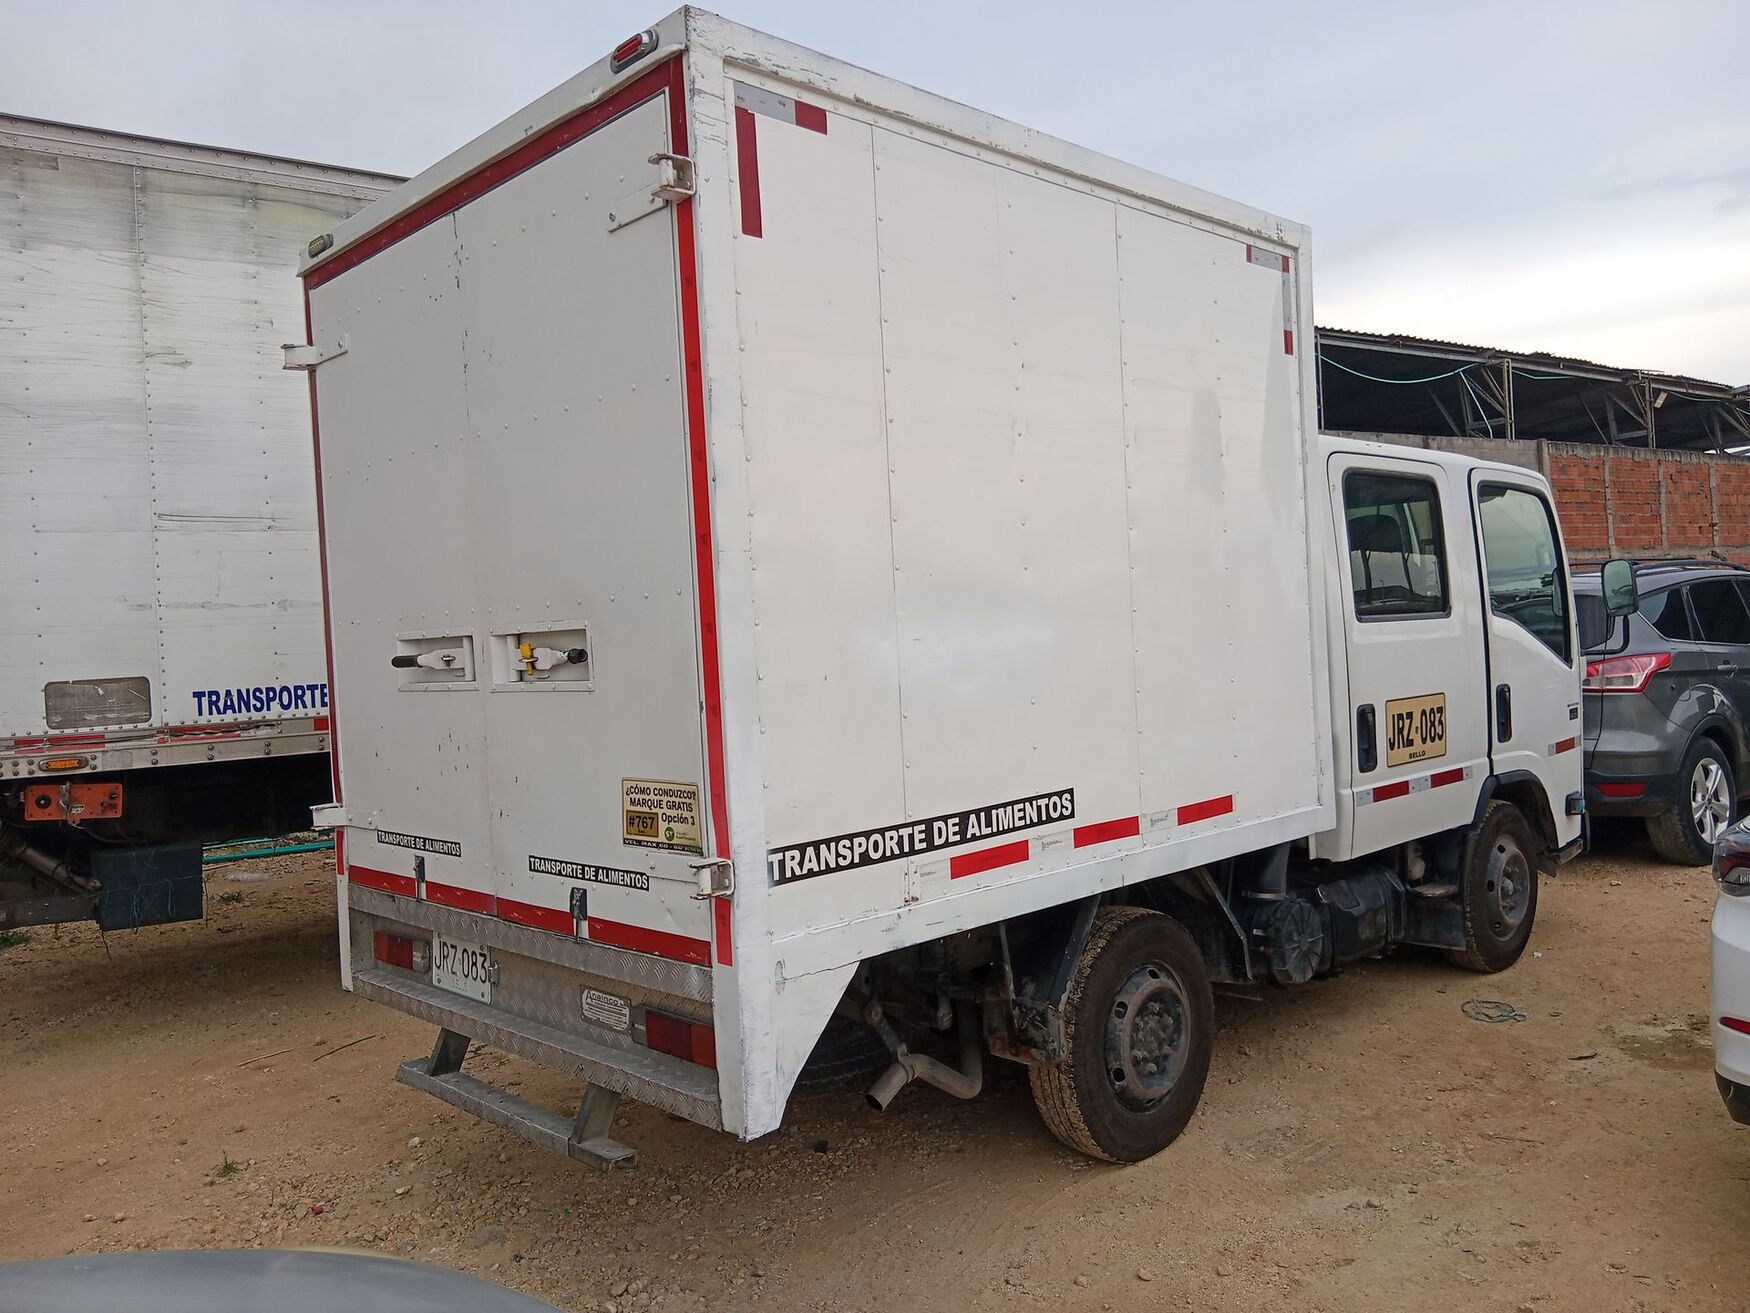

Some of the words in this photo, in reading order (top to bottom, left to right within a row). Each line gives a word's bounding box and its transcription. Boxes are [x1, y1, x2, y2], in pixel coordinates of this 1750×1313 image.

[192, 683, 328, 717] TRANSPORTE
[1408, 750, 1426, 760] BELLO
[625, 784, 652, 797] ¿CÓMO
[653, 788, 696, 800] CONDUZCO?
[630, 797, 664, 810] MARQUE
[666, 801, 693, 812] GRATIS
[628, 815, 655, 830] #767
[661, 812, 689, 825] Opción
[690, 816, 695, 825] 3
[377, 831, 416, 848] TRANSPORTE
[415, 837, 425, 850] DE
[425, 839, 461, 856] ALIMENTOS
[767, 823, 927, 882] TRANSPORTE
[933, 816, 961, 847] DE
[966, 792, 1073, 840] ALIMENTOS
[529, 857, 583, 878] TRANSPORTE
[584, 866, 596, 880] DE
[597, 868, 649, 889] ALIMENTOS
